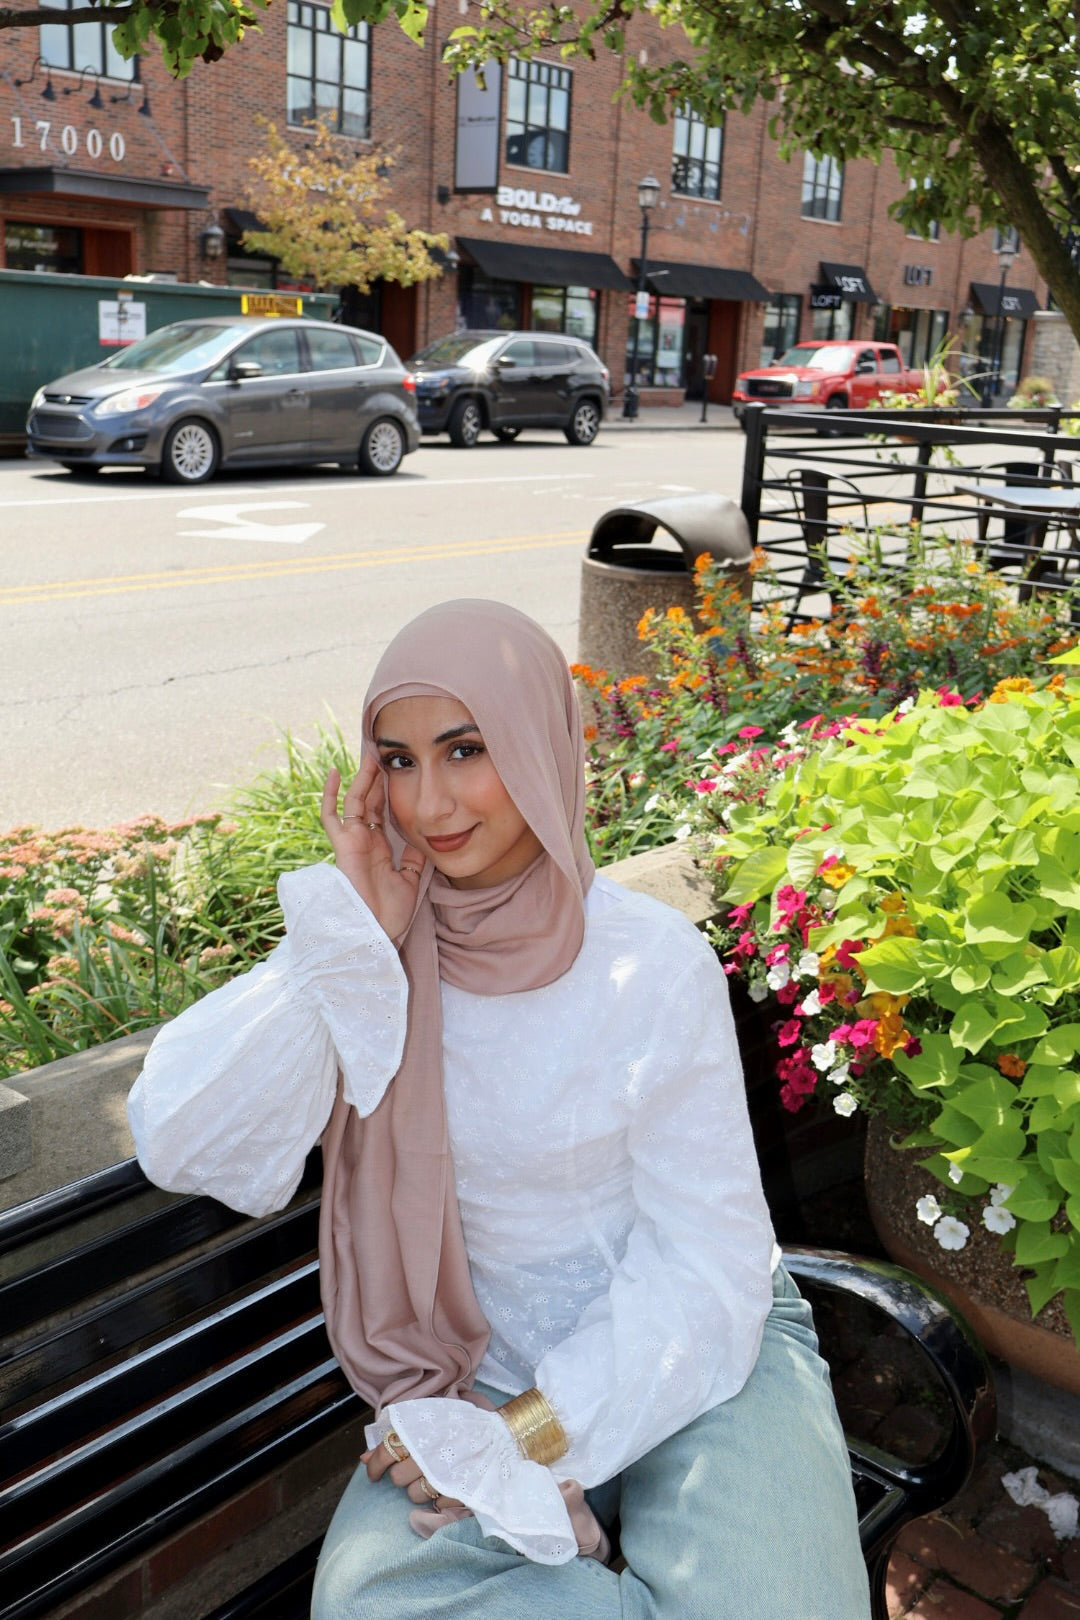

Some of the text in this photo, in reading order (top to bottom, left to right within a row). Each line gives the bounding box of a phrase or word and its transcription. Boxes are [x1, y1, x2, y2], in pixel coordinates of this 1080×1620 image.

[10, 117, 126, 161] 17000
[480, 207, 593, 236] A YOGA SPACE
[835, 276, 866, 293] LOFT
[904, 265, 932, 286] LOFT
[811, 294, 841, 307] LOFT
[1001, 296, 1023, 311] OFT
